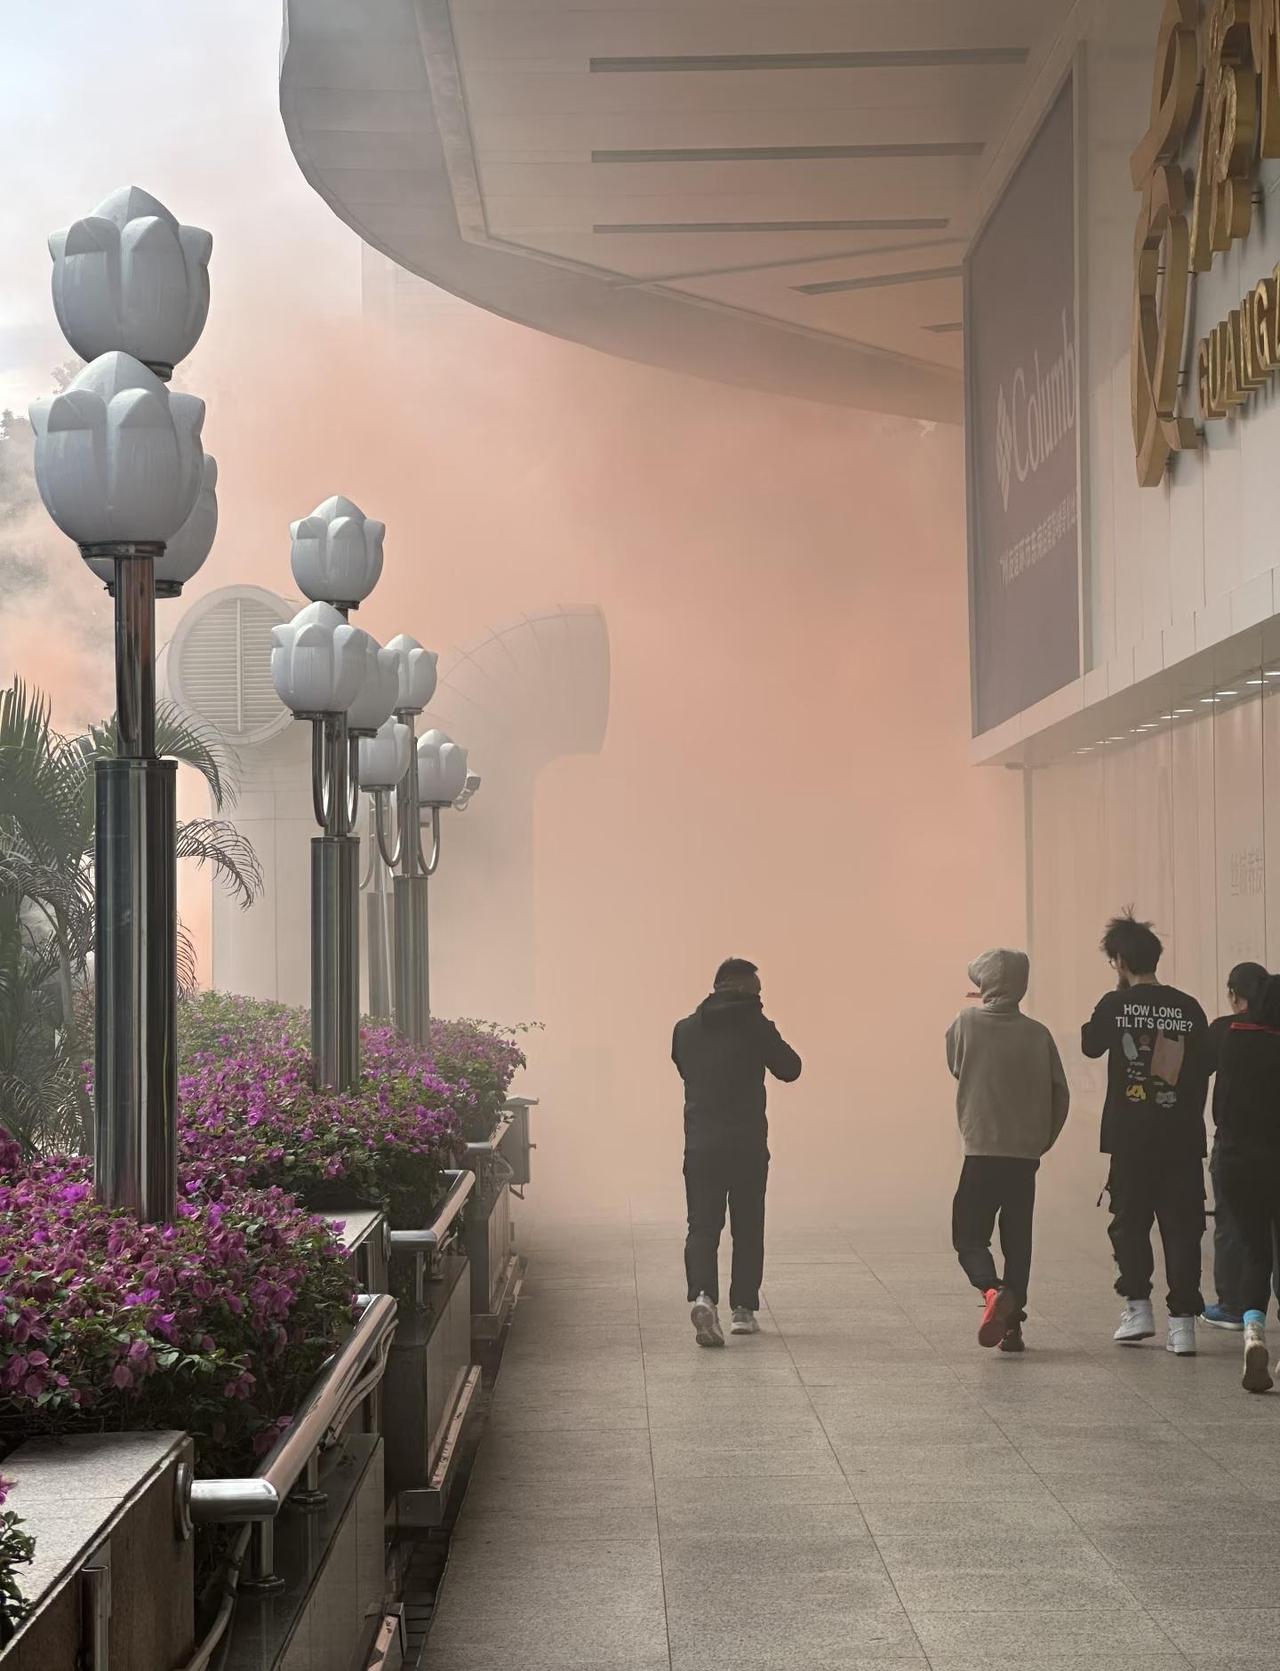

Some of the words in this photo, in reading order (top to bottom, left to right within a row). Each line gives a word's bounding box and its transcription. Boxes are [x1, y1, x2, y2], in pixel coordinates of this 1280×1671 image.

[1123, 1004, 1149, 1017] HOW
[1152, 1005, 1183, 1019] LONG
[1115, 1016, 1132, 1028] TIL
[1134, 1017, 1154, 1029] IT'S
[1156, 1018, 1193, 1032] GONE?
